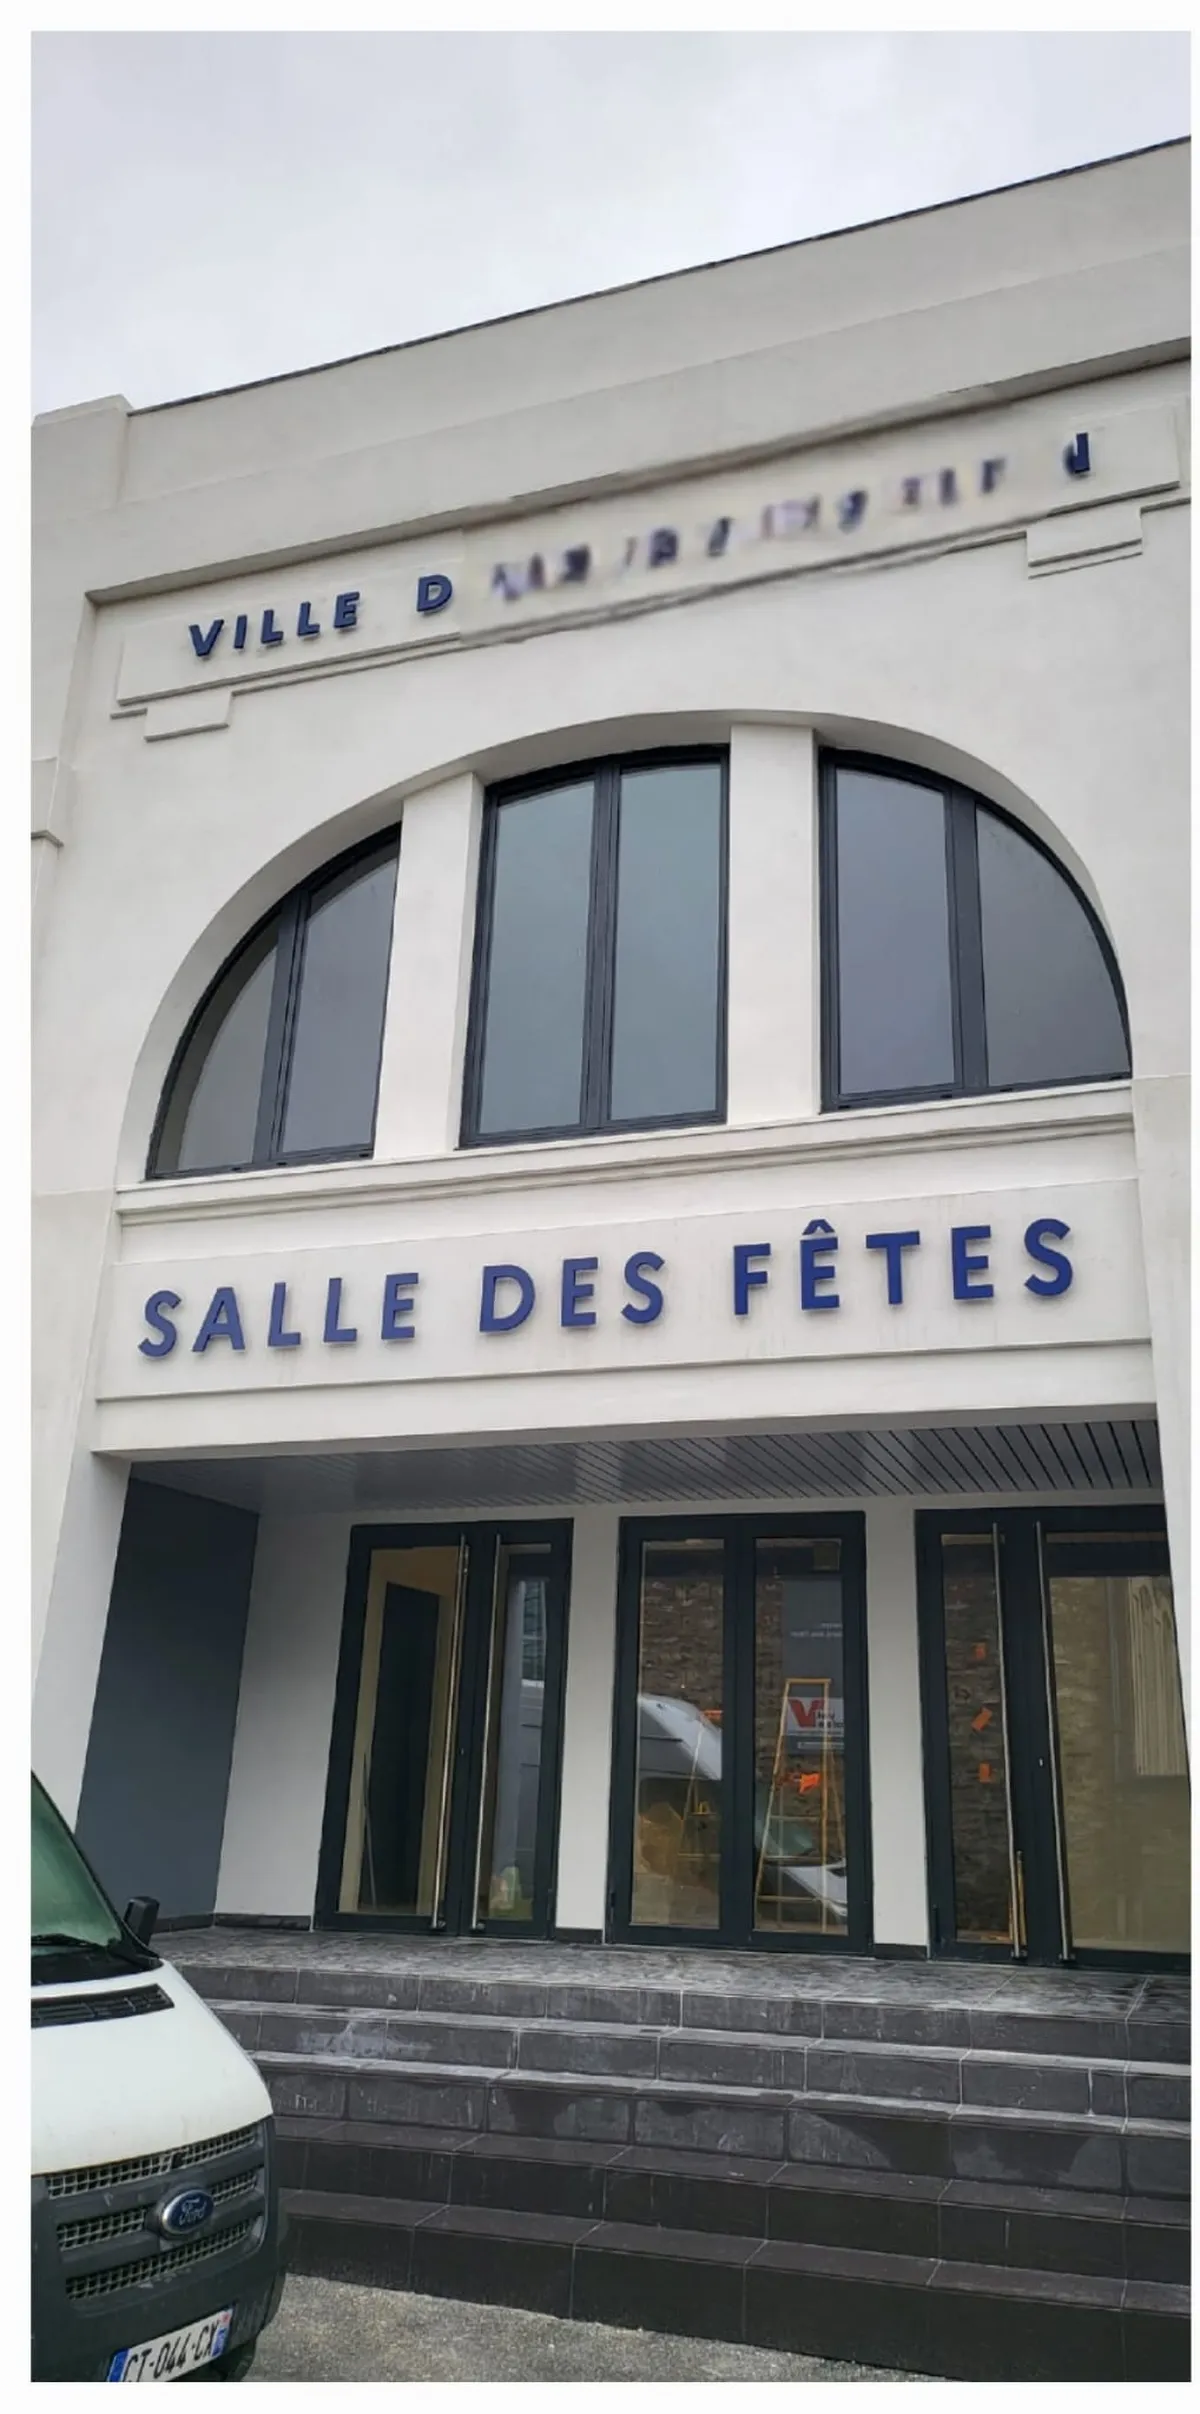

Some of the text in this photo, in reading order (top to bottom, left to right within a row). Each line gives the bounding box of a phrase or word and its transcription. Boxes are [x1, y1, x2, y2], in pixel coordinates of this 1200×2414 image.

[189, 591, 360, 656] VILLE
[138, 1218, 1075, 1358] SALLE DES FÊTES
[178, 2196, 208, 2226] Ford
